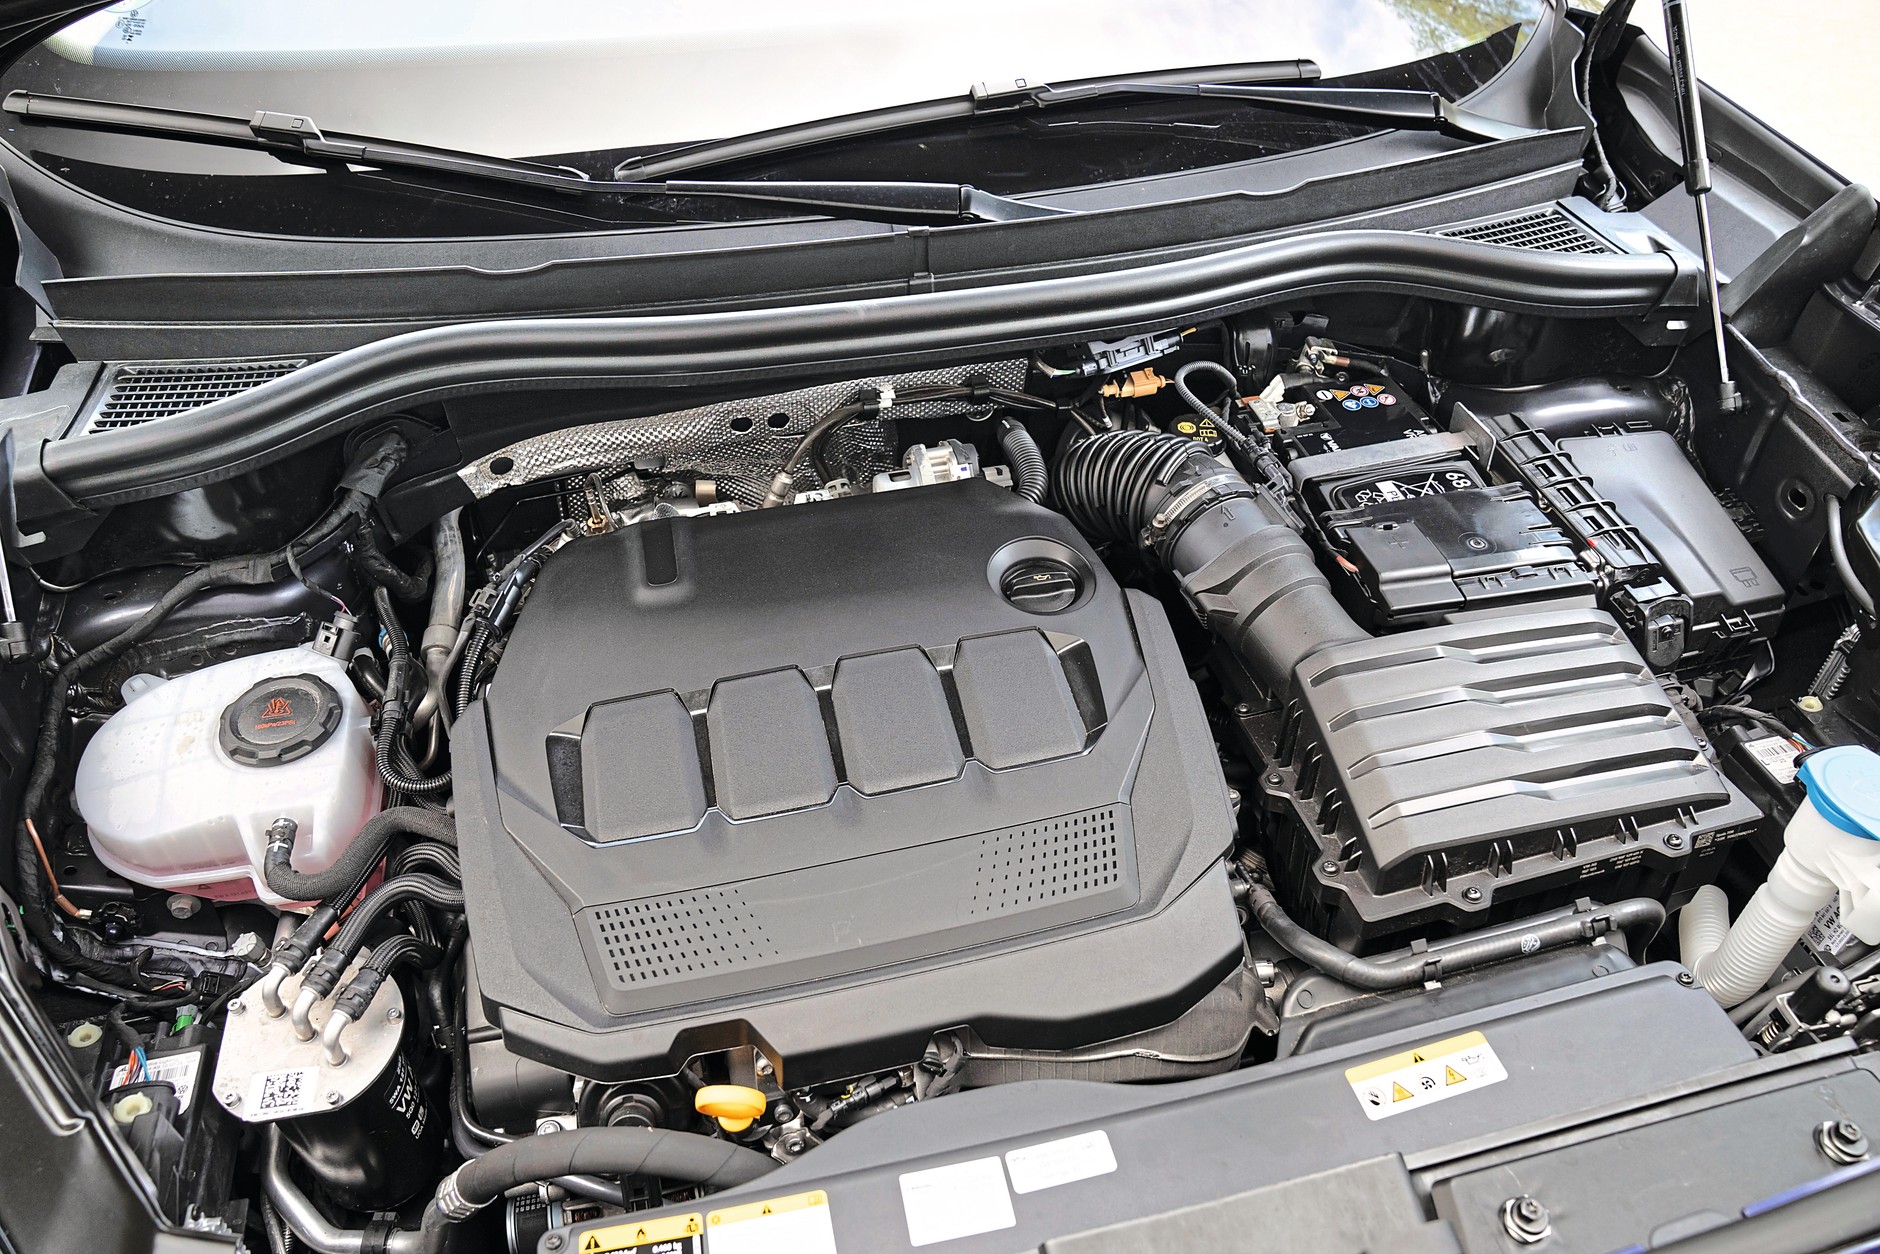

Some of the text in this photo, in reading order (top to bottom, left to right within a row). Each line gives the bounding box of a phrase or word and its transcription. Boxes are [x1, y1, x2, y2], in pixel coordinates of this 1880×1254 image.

[1445, 472, 1472, 490] 68
[1823, 915, 1836, 929] VW
[396, 1077, 413, 1113] VW
